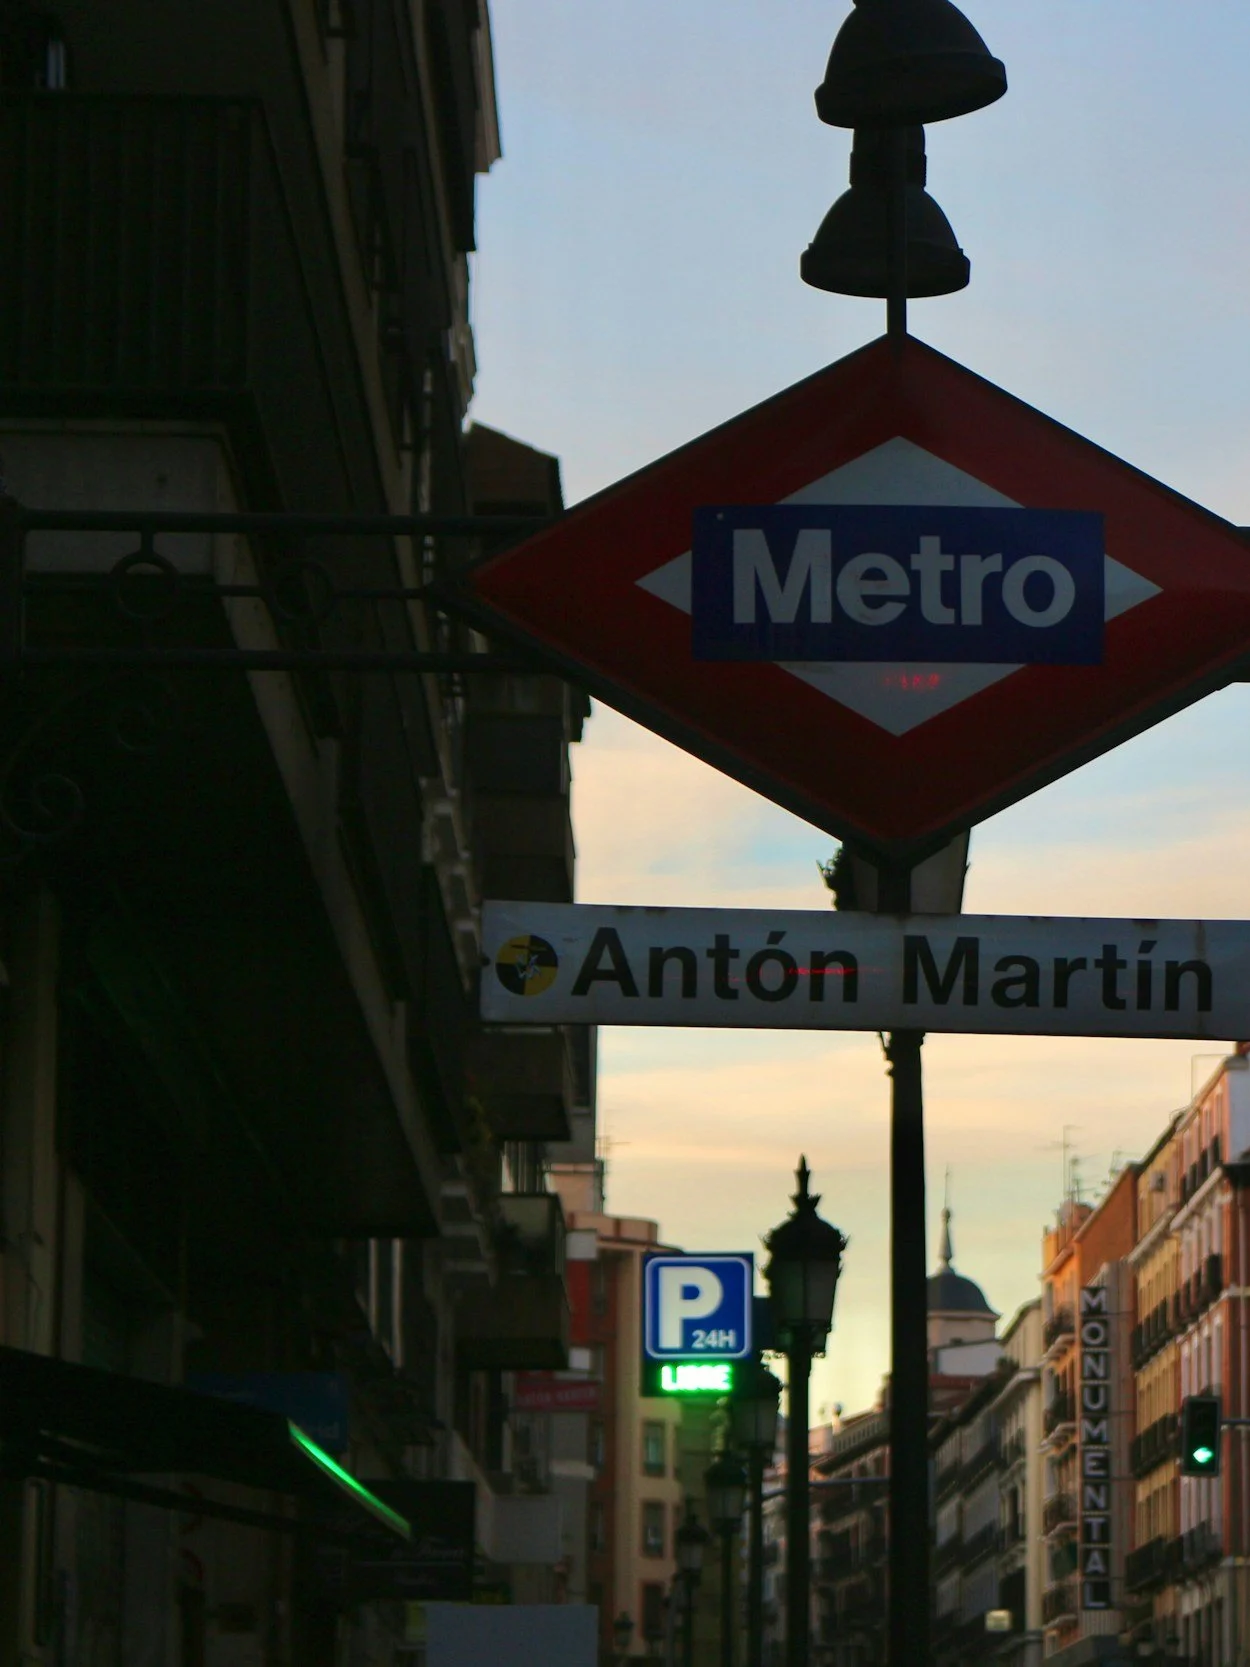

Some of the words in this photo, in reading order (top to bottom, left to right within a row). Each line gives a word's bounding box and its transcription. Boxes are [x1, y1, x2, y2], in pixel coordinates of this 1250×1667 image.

[733, 528, 1076, 628] Metro
[571, 927, 858, 1003] Antón
[903, 935, 1213, 1011] Martín
[658, 1266, 723, 1349] P
[691, 1329, 737, 1349] 24H
[1081, 1287, 1109, 1609] MONUMENTAL
